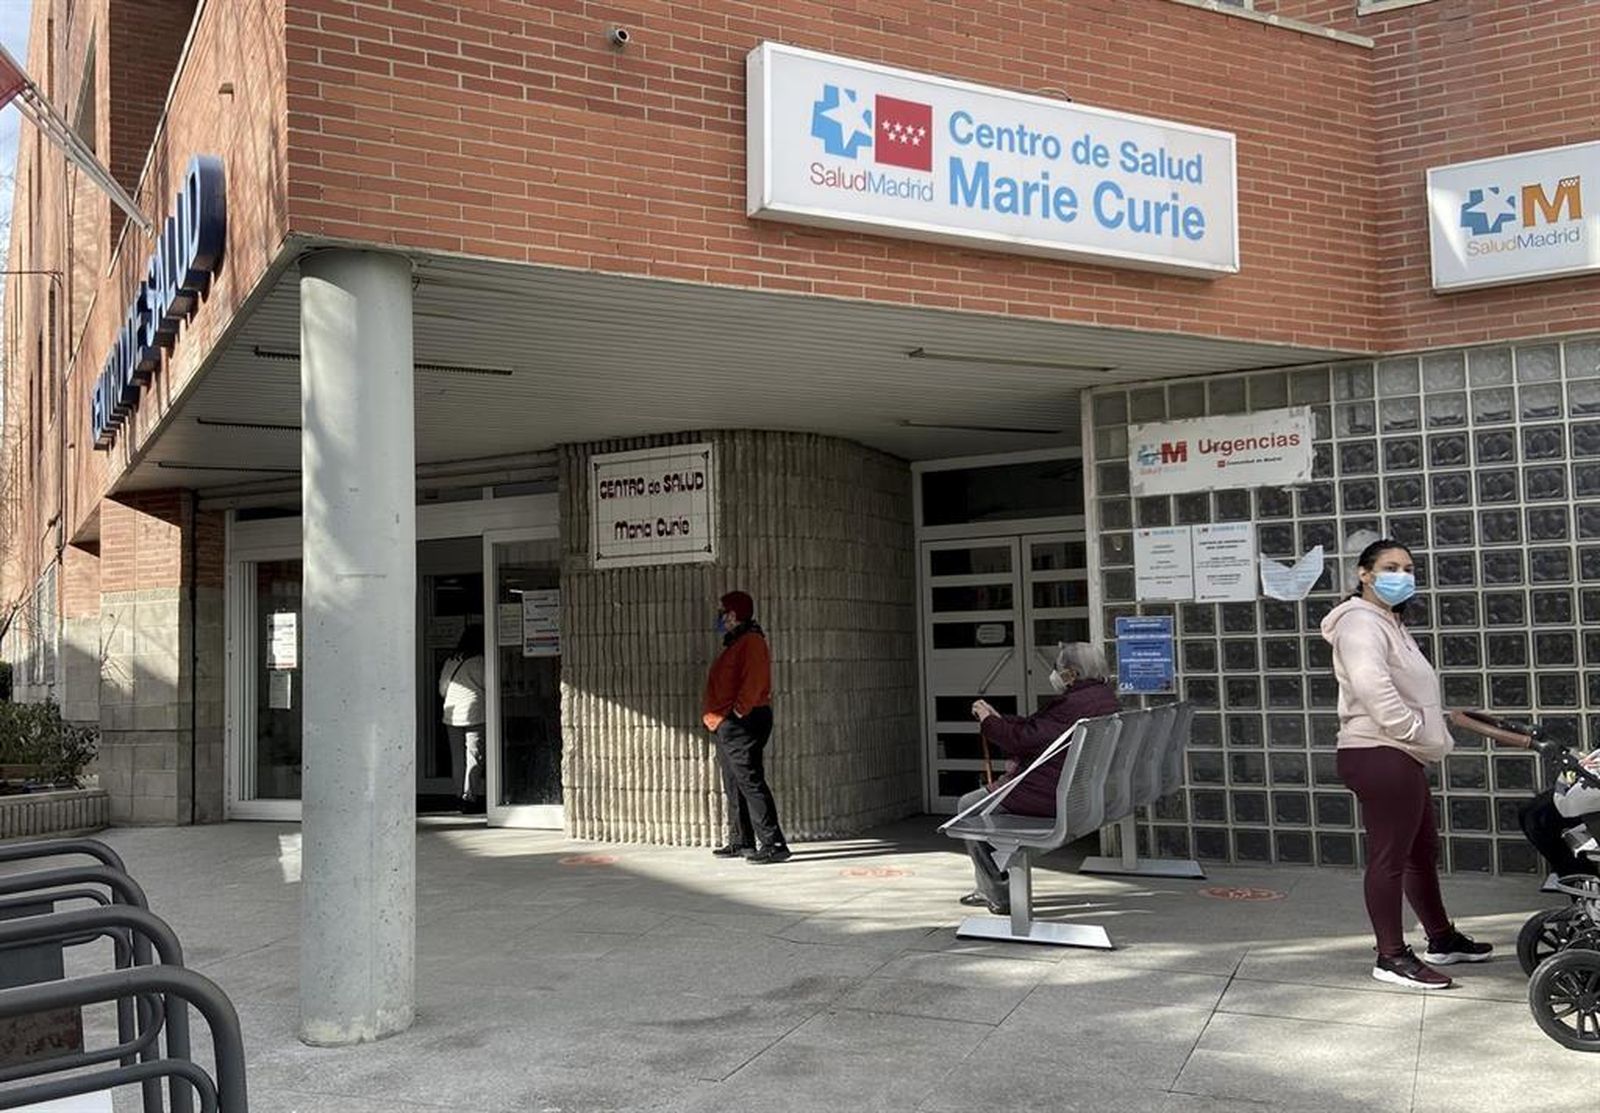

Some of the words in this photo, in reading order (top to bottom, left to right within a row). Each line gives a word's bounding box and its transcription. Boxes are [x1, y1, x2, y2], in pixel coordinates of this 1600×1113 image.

[948, 111, 1061, 161] Centro
[1073, 134, 1109, 166] de
[1119, 141, 1203, 185] Salud
[810, 163, 935, 203] SaludMadrid
[949, 157, 1078, 222] Marie
[1093, 181, 1205, 240] Curie
[146, 153, 225, 348] SALUD
[1467, 227, 1580, 256] SaludMadrid
[1198, 432, 1300, 456] Urgencias
[599, 477, 645, 500] CENTRO
[648, 480, 661, 495] de
[663, 471, 704, 493] SALUD
[656, 516, 689, 538] Curie
